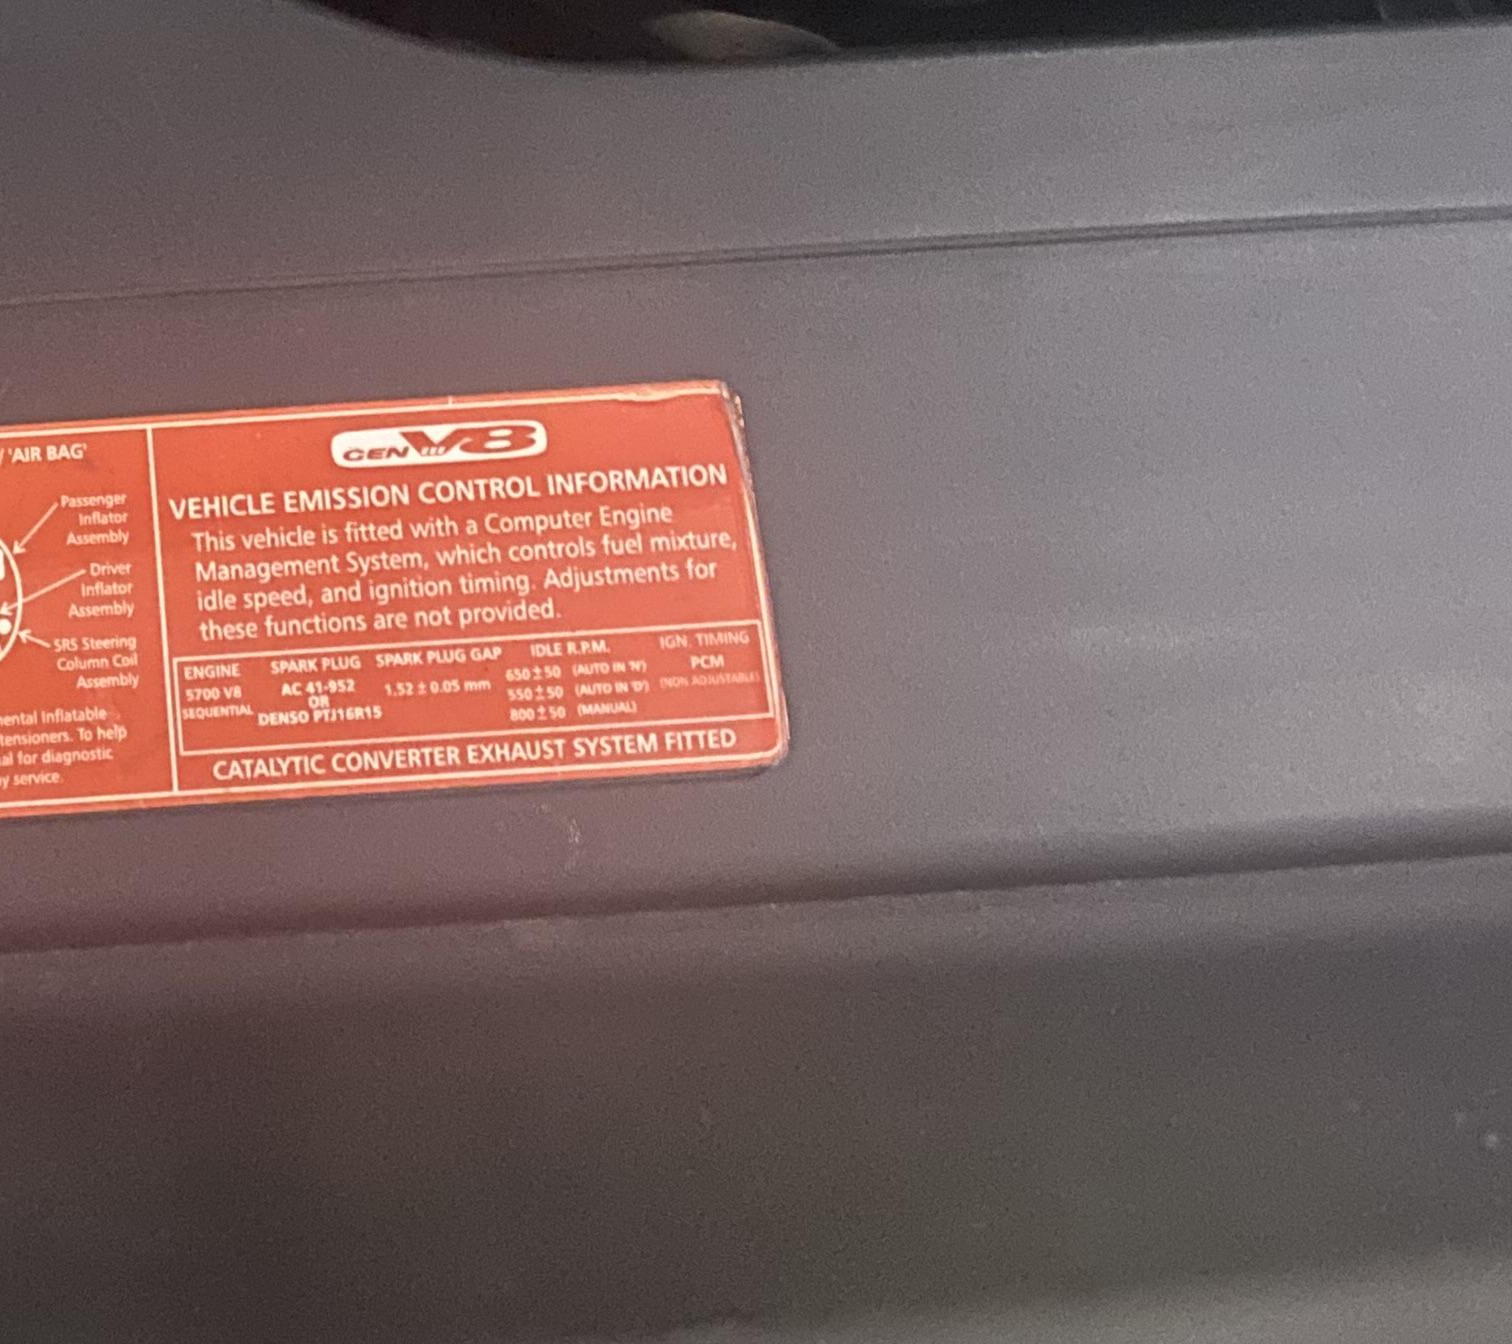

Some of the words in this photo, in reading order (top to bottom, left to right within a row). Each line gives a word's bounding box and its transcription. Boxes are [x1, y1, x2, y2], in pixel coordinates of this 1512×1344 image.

[342, 446, 409, 461] GEN
[401, 424, 535, 456] V8
[169, 492, 273, 519] VEHICLE
[283, 484, 409, 512] EMISSION
[418, 476, 539, 503] CONTROL
[547, 464, 726, 493] INFORMATION
[60, 493, 126, 508] Passenger
[78, 510, 127, 525] Inflator
[191, 530, 236, 551] This
[241, 525, 315, 549] vehicle
[321, 524, 338, 544] is
[344, 519, 403, 542] fitted
[409, 515, 458, 538] with
[464, 518, 478, 535] a
[484, 510, 591, 533] Computer
[599, 505, 672, 527] Engine
[66, 529, 129, 545] Assembly
[195, 555, 339, 583] Management
[346, 551, 428, 576] System,
[435, 542, 501, 565] which
[508, 536, 595, 561] controls
[601, 532, 642, 555] fuel
[649, 531, 736, 551] mixture,
[89, 562, 131, 576] Driver
[81, 581, 132, 596] Inflator
[197, 588, 236, 611] idle
[243, 583, 312, 612] speed,
[320, 579, 361, 603] and
[369, 577, 452, 605] ignition
[544, 563, 679, 591] Adjustments
[685, 557, 716, 579] for
[68, 599, 134, 617] Assembly
[199, 619, 257, 641] these
[264, 614, 366, 636] functions
[373, 611, 408, 630] are
[414, 606, 451, 626] not
[53, 636, 78, 652] SRS
[81, 636, 137, 650] Steering
[695, 630, 749, 645] TIMING
[375, 651, 422, 666] SPARK
[425, 648, 466, 663] PLUG
[469, 645, 502, 661] GAP
[530, 642, 562, 657] IDLE
[56, 656, 109, 671] Column
[111, 651, 138, 667] Coil
[270, 658, 317, 674] SPARK
[320, 654, 361, 670] PLUG
[690, 654, 724, 668] PCM
[183, 662, 239, 679] ENGINE
[76, 672, 139, 688] Assembly
[185, 686, 221, 701] 5700
[222, 685, 242, 698] V8
[281, 682, 301, 695] AC
[307, 694, 329, 709] OR
[40, 706, 107, 722] Inflatable
[182, 704, 253, 719] SEQUENTIAL
[257, 710, 309, 725] DENSO
[213, 754, 324, 779] CATALYTIC
[331, 745, 460, 772] CONVERTER
[466, 738, 564, 763] EXHAUST
[573, 732, 658, 757] SYSTEM
[664, 727, 736, 750] FITTED
